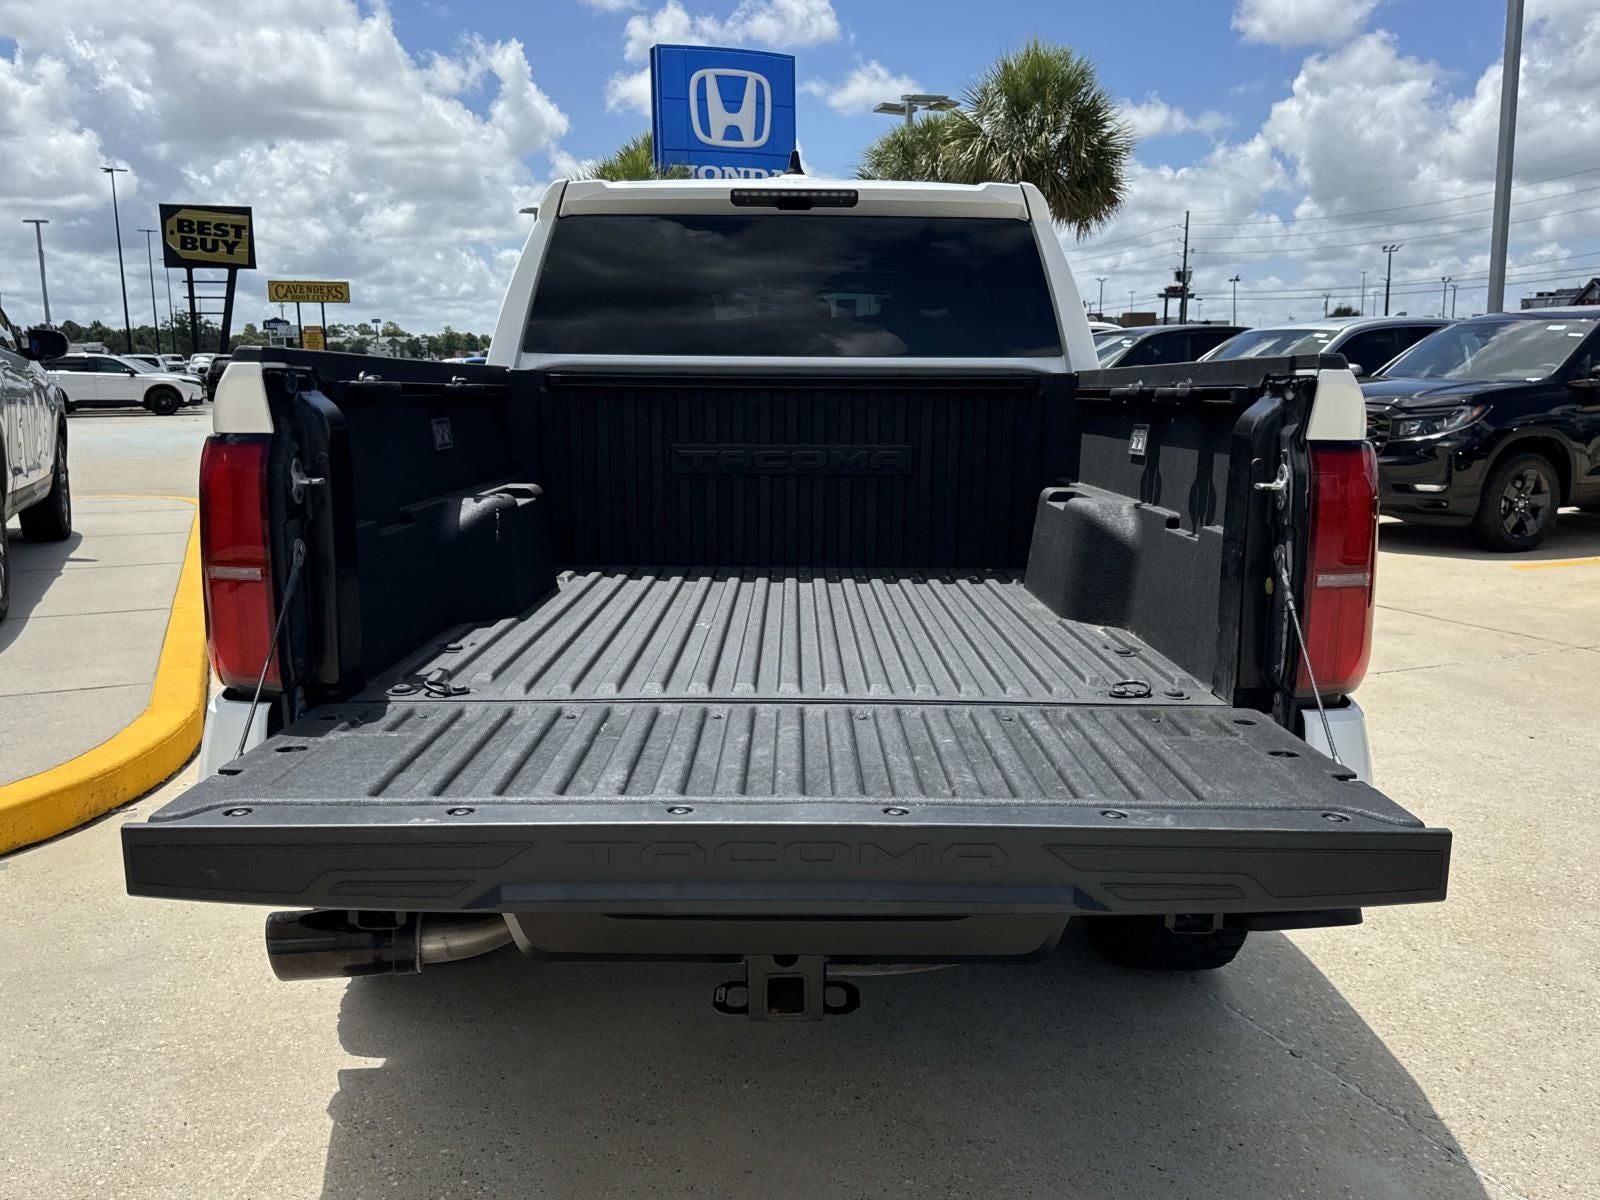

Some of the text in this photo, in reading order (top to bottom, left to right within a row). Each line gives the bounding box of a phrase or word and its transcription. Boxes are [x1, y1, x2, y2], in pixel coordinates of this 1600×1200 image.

[670, 164, 786, 179] OND
[177, 218, 247, 239] BEST
[180, 235, 240, 255] BUY
[274, 283, 344, 299] CAVENDER'S
[676, 450, 907, 468] TACOMA
[563, 841, 1009, 867] TACOMA
